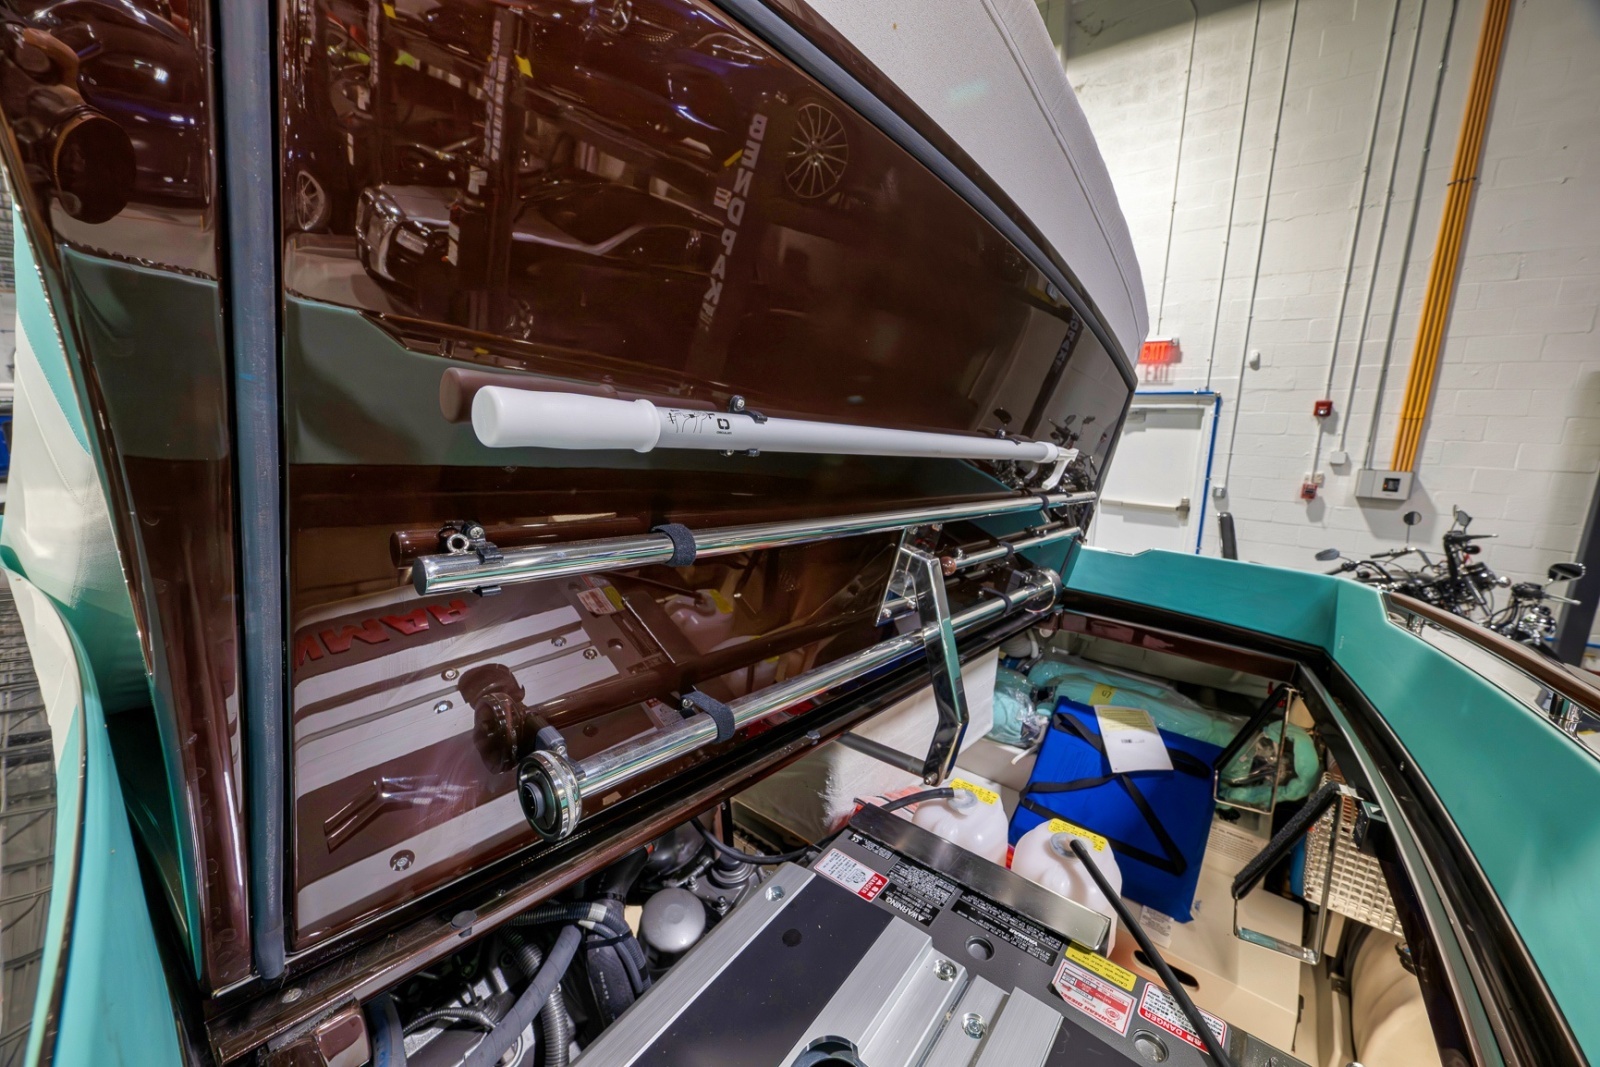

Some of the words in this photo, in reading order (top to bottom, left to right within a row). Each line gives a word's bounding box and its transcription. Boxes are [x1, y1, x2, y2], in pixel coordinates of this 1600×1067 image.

[1142, 343, 1168, 361] EXIT
[861, 875, 878, 893] DANGER
[884, 896, 918, 918] WARNING
[1008, 927, 1038, 946] YANMAR
[1105, 972, 1127, 987] CAUTION
[1084, 1006, 1116, 1025] YANMAR
[1144, 1011, 1182, 1035] DANGER
